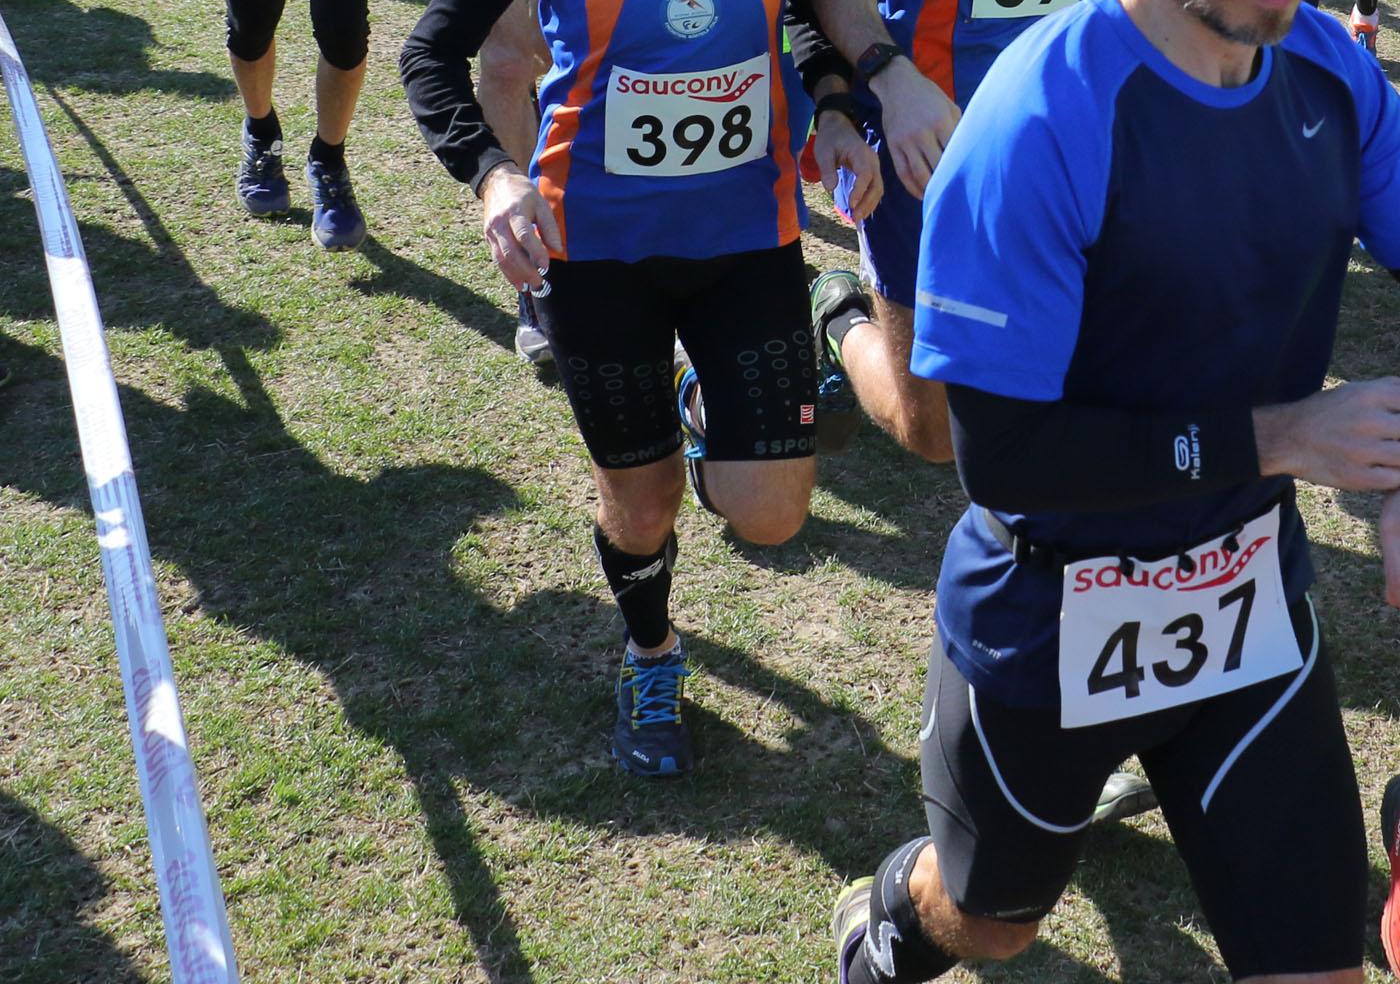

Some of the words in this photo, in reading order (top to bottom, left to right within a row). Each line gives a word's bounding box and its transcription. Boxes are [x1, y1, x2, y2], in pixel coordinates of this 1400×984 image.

[616, 70, 738, 95] saucony
[626, 104, 753, 167] 398
[1189, 424, 1201, 480] Kalenji
[1073, 546, 1238, 593] saucony
[1086, 578, 1257, 700] 437
